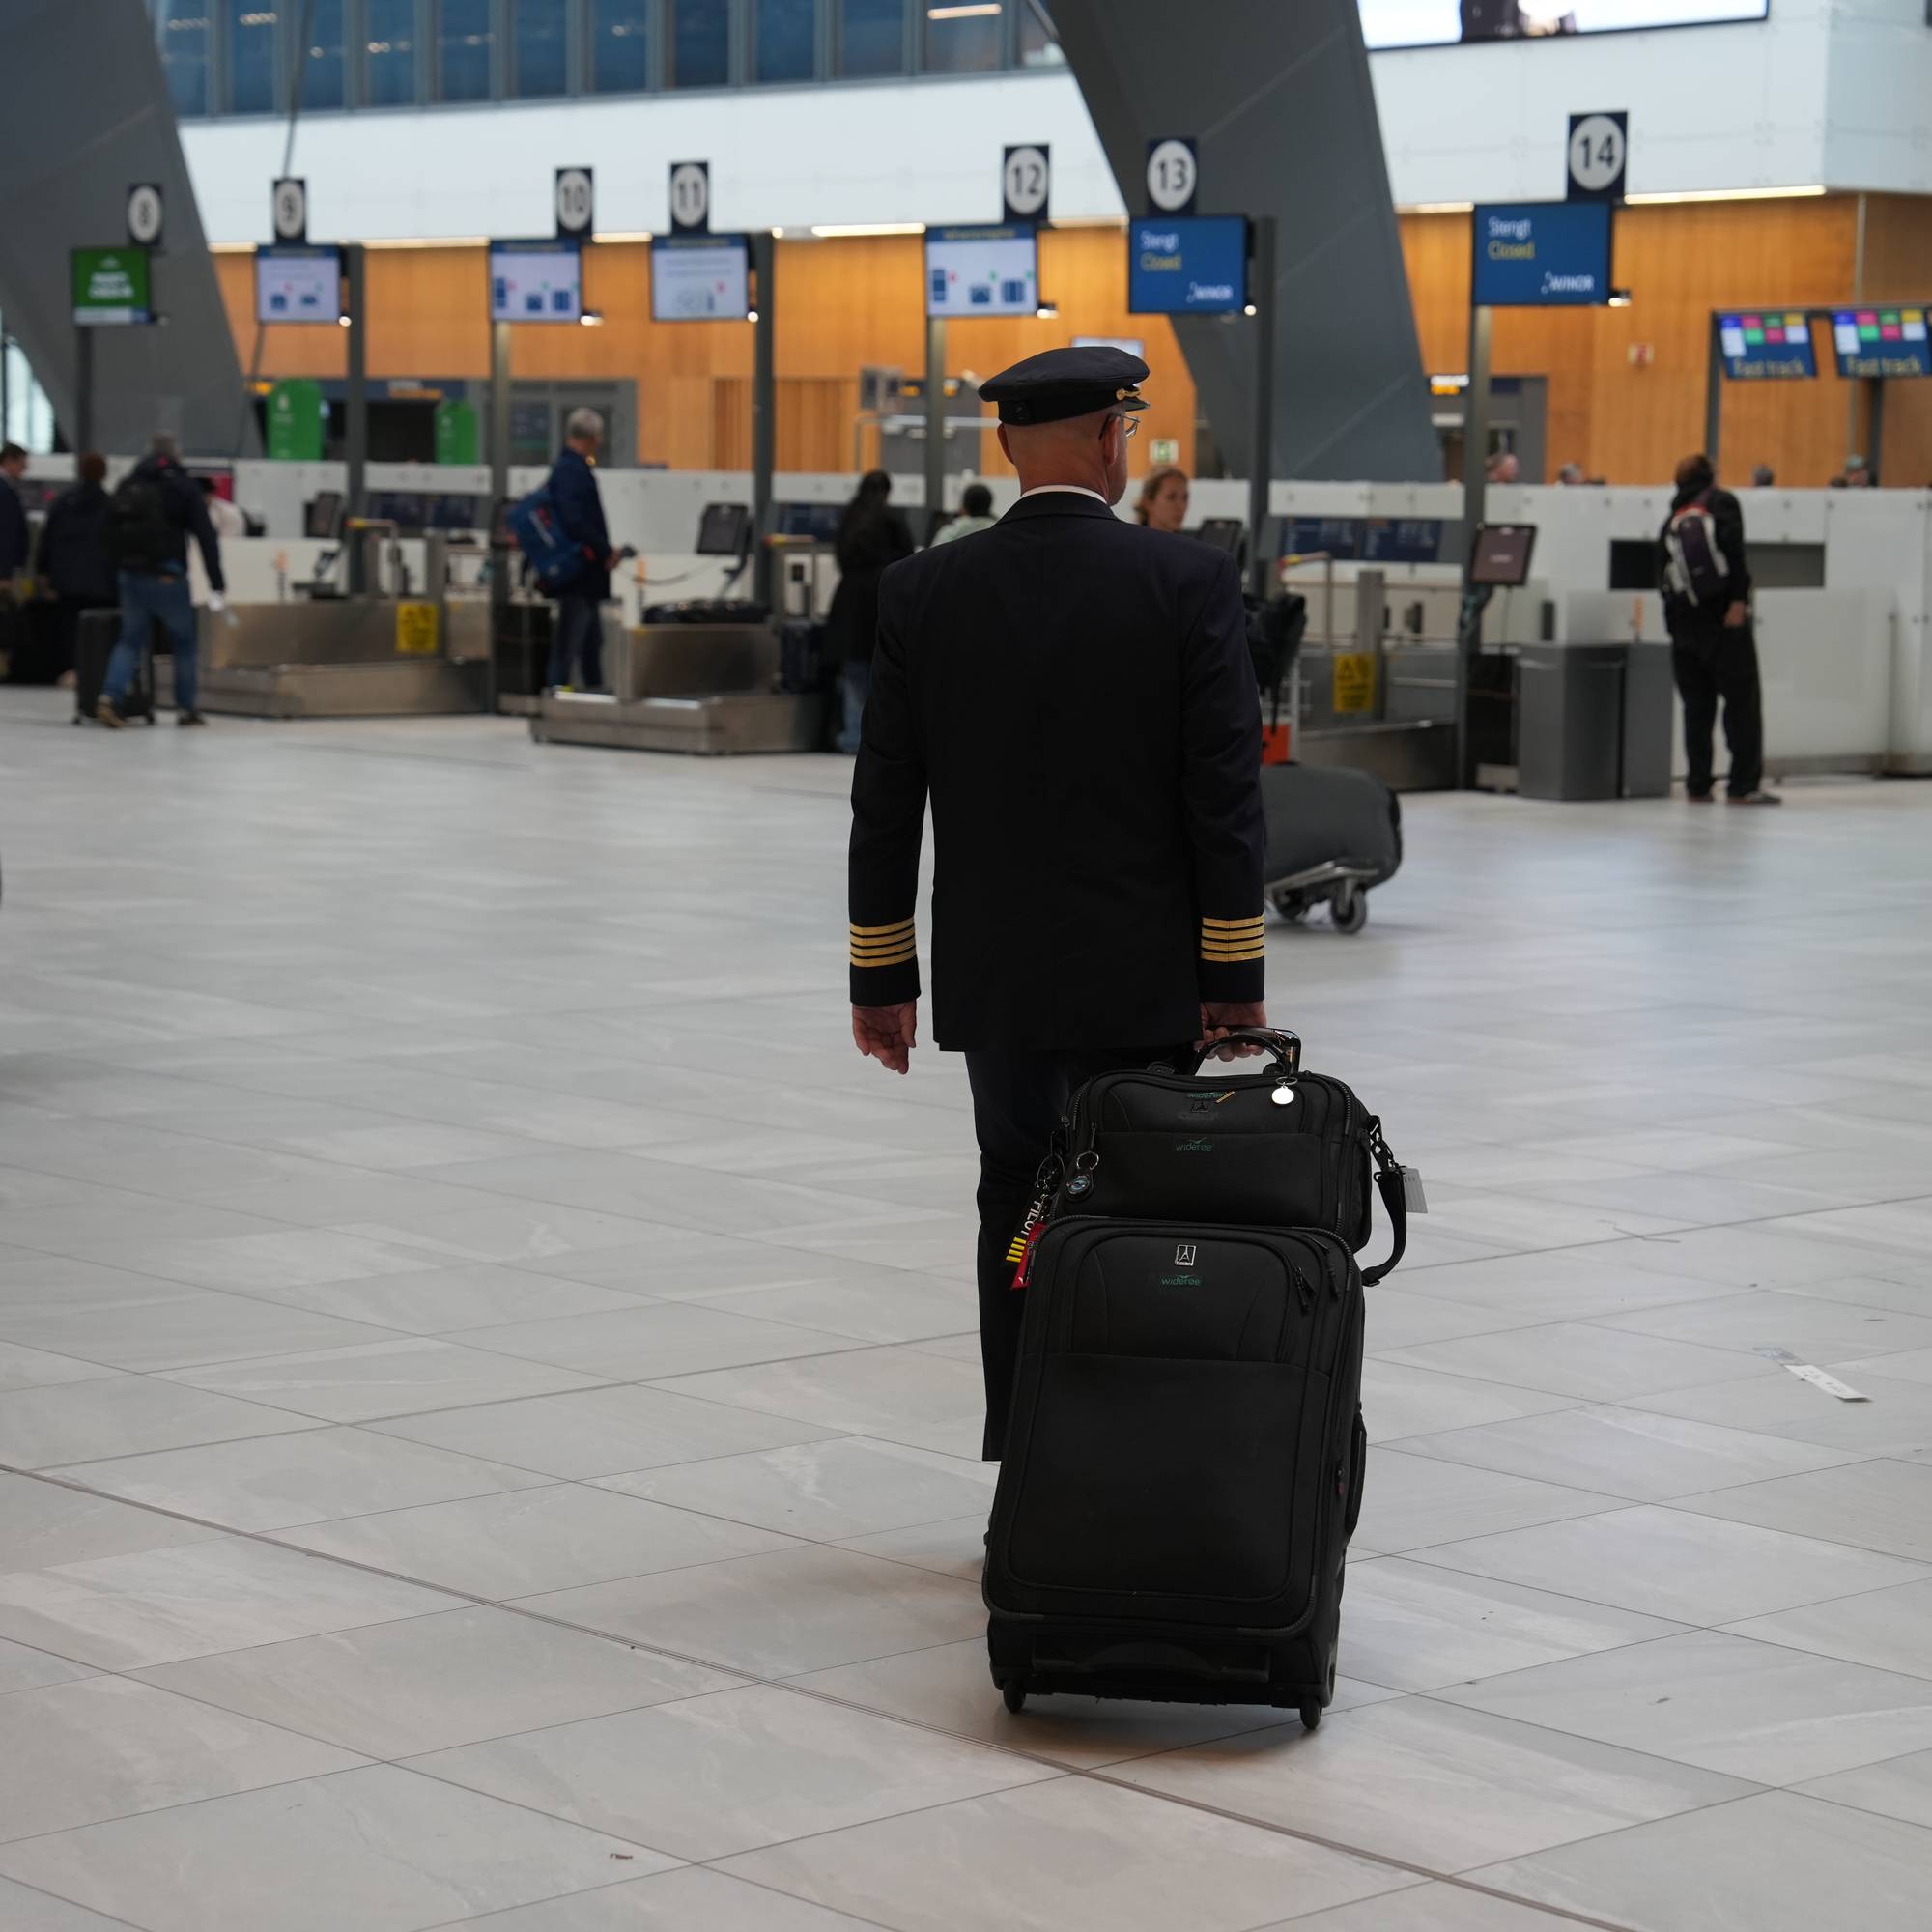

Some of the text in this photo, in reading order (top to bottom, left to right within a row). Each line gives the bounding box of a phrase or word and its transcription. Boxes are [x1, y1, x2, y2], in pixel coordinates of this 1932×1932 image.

[1579, 133, 1614, 170] 14
[1012, 163, 1041, 195] 12
[1158, 158, 1186, 191] 13
[283, 195, 294, 222] 9
[562, 184, 585, 213] 10
[677, 180, 701, 210] 11
[1140, 252, 1181, 272] Closed
[1488, 240, 1535, 260] Closed
[1847, 354, 1921, 374] Fast track
